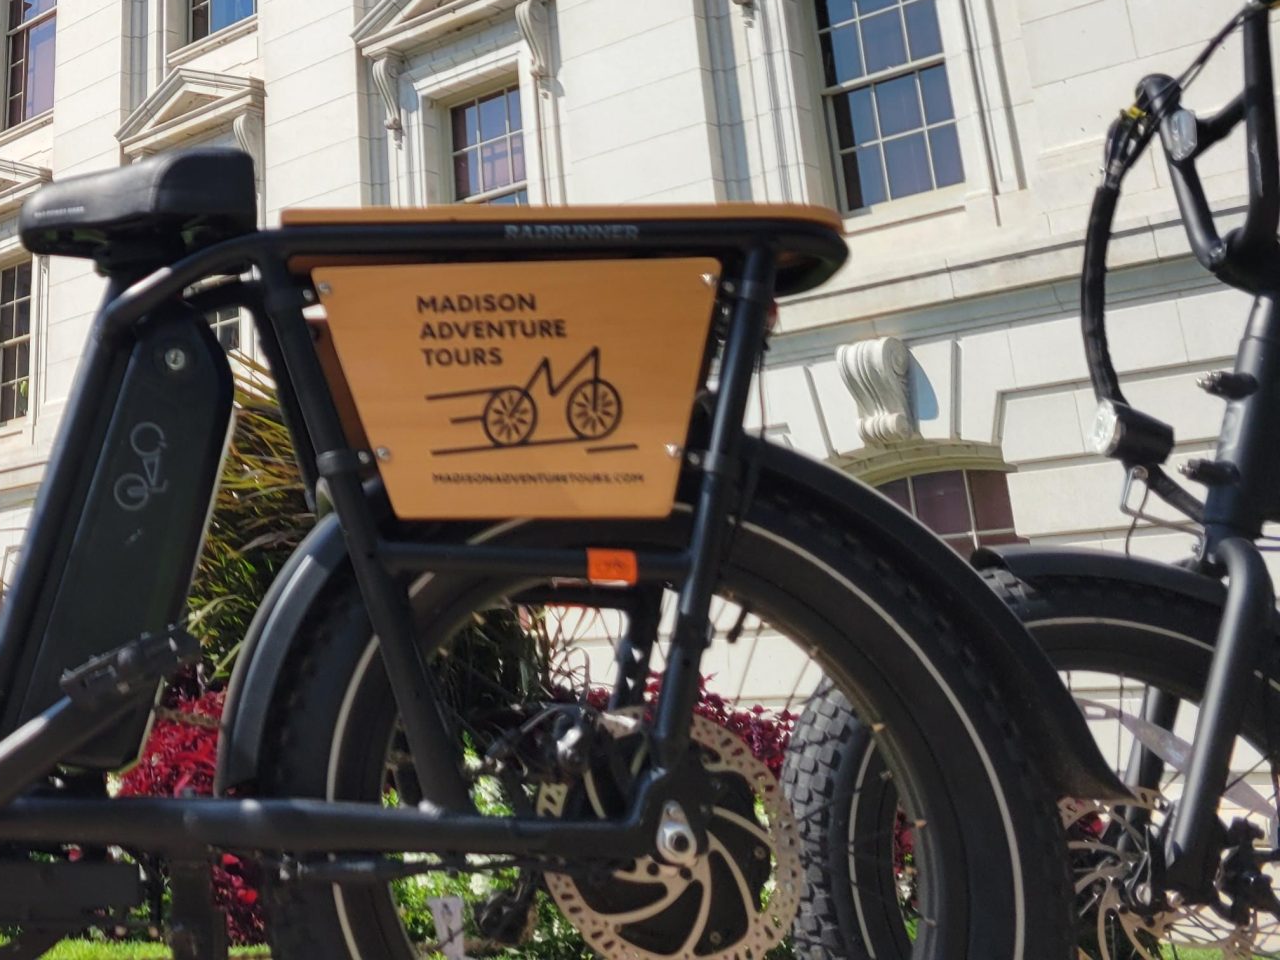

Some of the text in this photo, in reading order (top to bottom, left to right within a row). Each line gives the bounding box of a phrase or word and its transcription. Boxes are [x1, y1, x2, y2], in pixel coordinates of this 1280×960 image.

[504, 224, 639, 239] RADRUNNER
[417, 293, 536, 313] MADISON
[420, 319, 567, 339] ADVENTURE
[421, 347, 502, 366] TOURS
